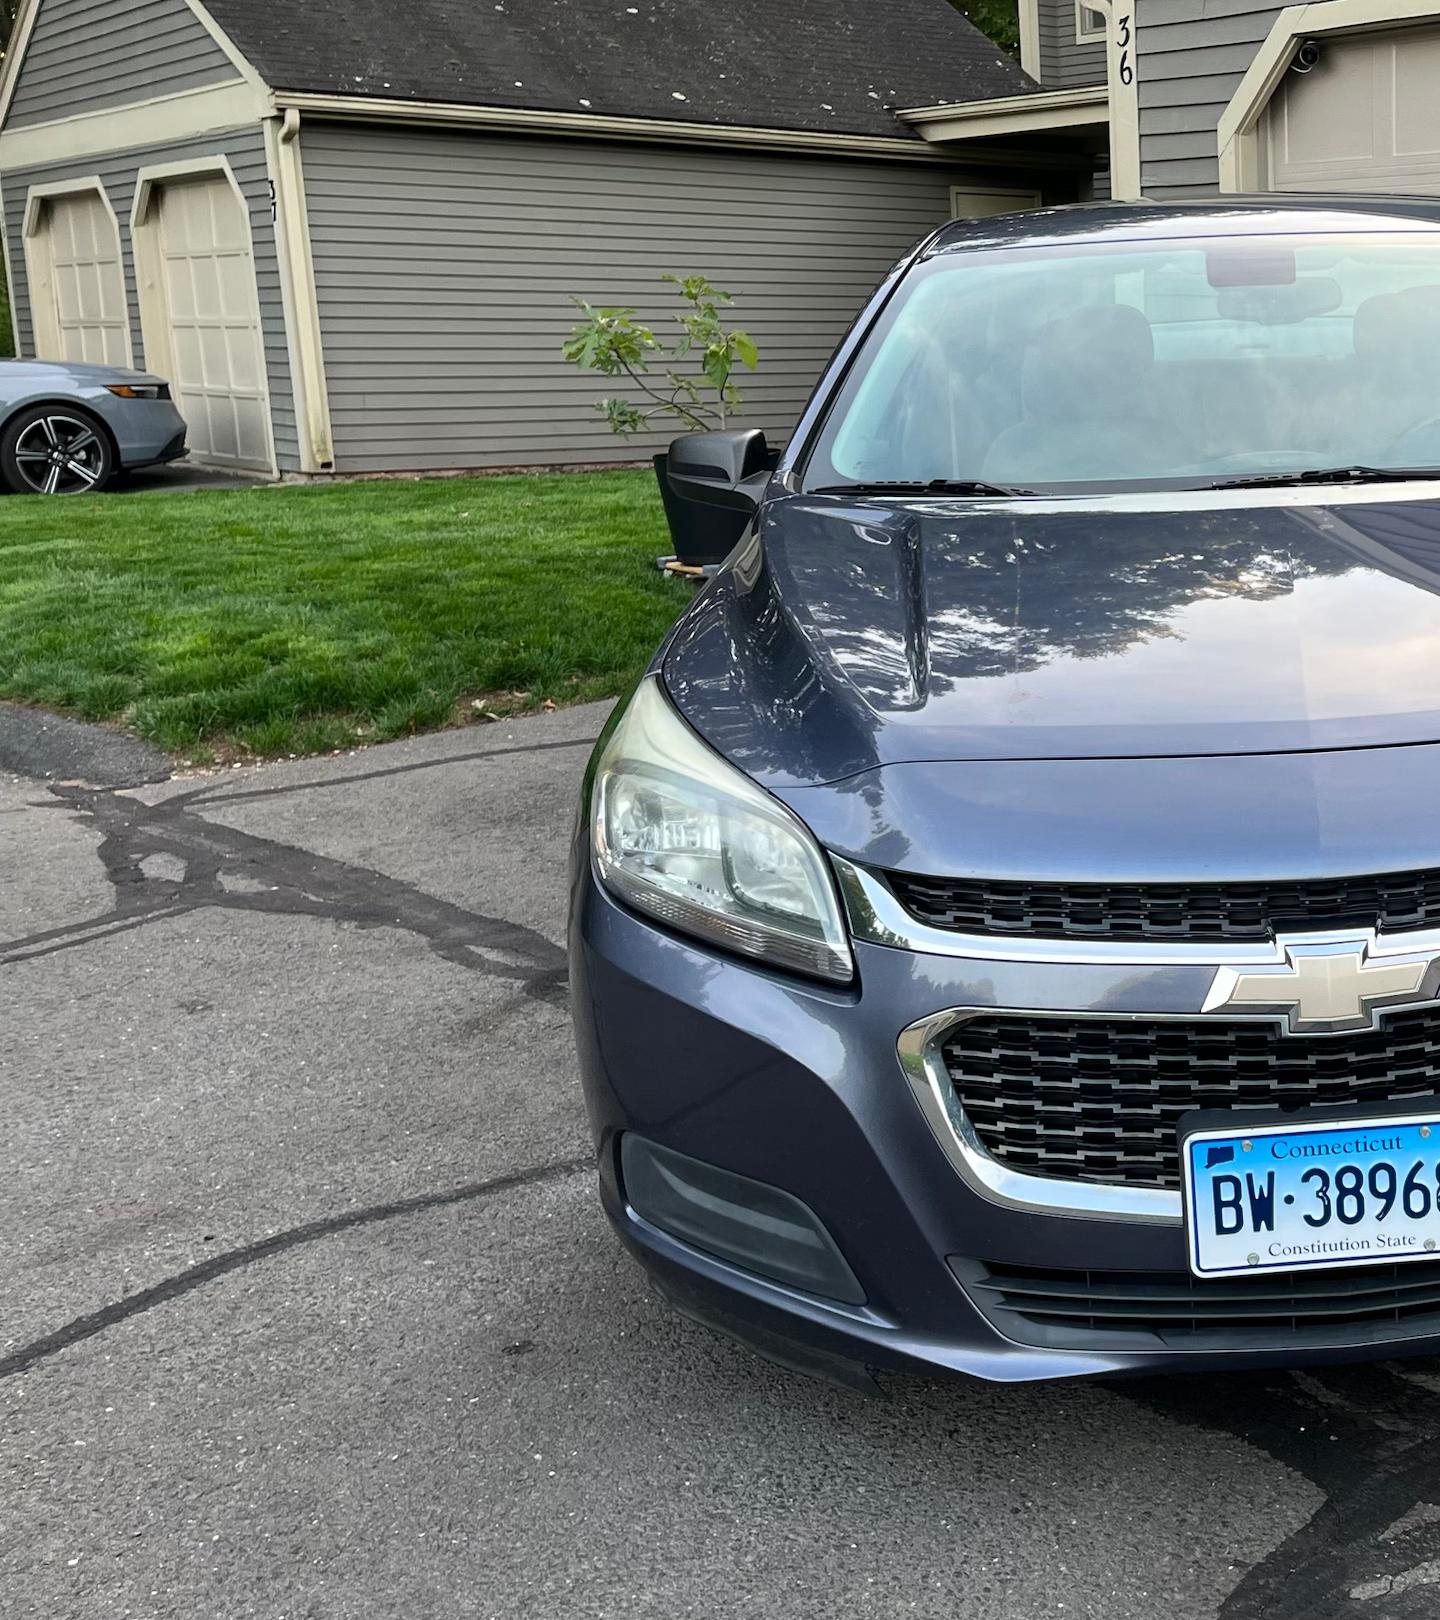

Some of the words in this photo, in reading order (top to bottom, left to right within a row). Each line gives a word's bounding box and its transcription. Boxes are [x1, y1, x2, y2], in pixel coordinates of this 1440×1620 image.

[1116, 15, 1133, 85] 36
[1271, 1135, 1404, 1160] Connecticut
[1268, 1237, 1371, 1257] Constitution
[1376, 1234, 1417, 1248] State
